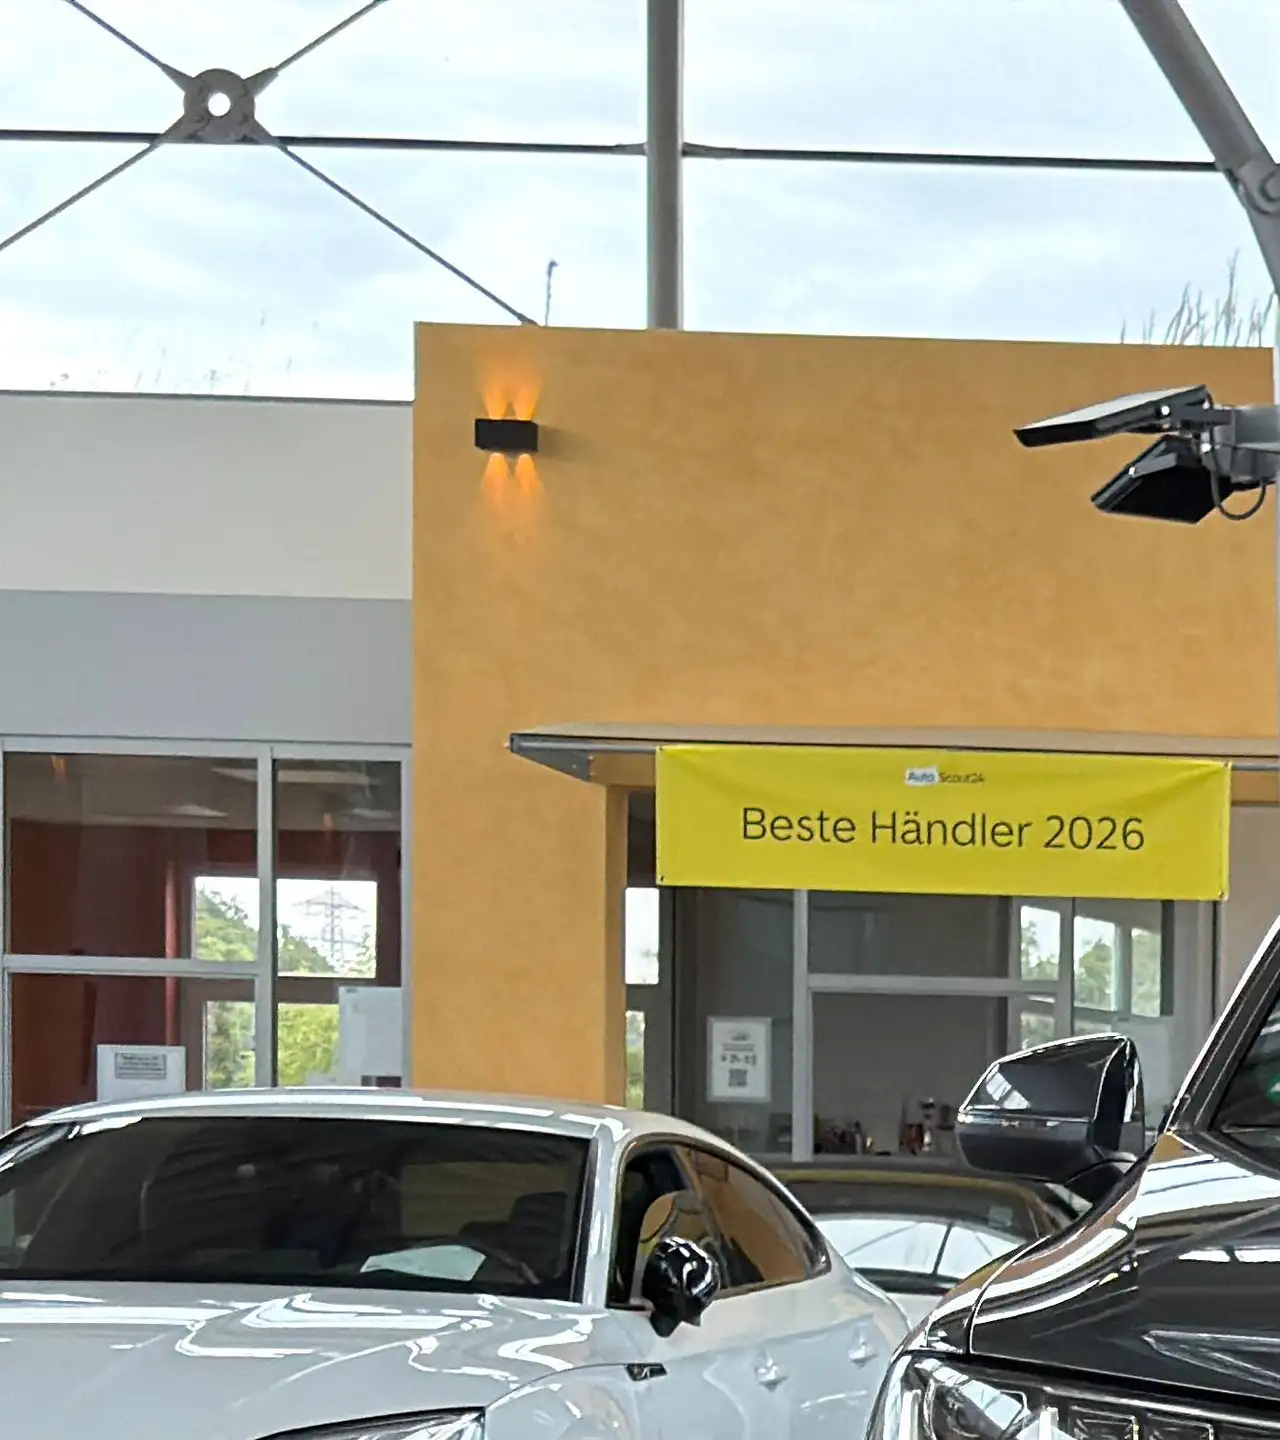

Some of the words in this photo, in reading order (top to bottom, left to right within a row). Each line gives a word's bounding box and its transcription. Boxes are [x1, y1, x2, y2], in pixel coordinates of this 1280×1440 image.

[741, 807, 856, 844] Beste
[871, 810, 1033, 849] Händler
[1042, 815, 1146, 851] 2026
